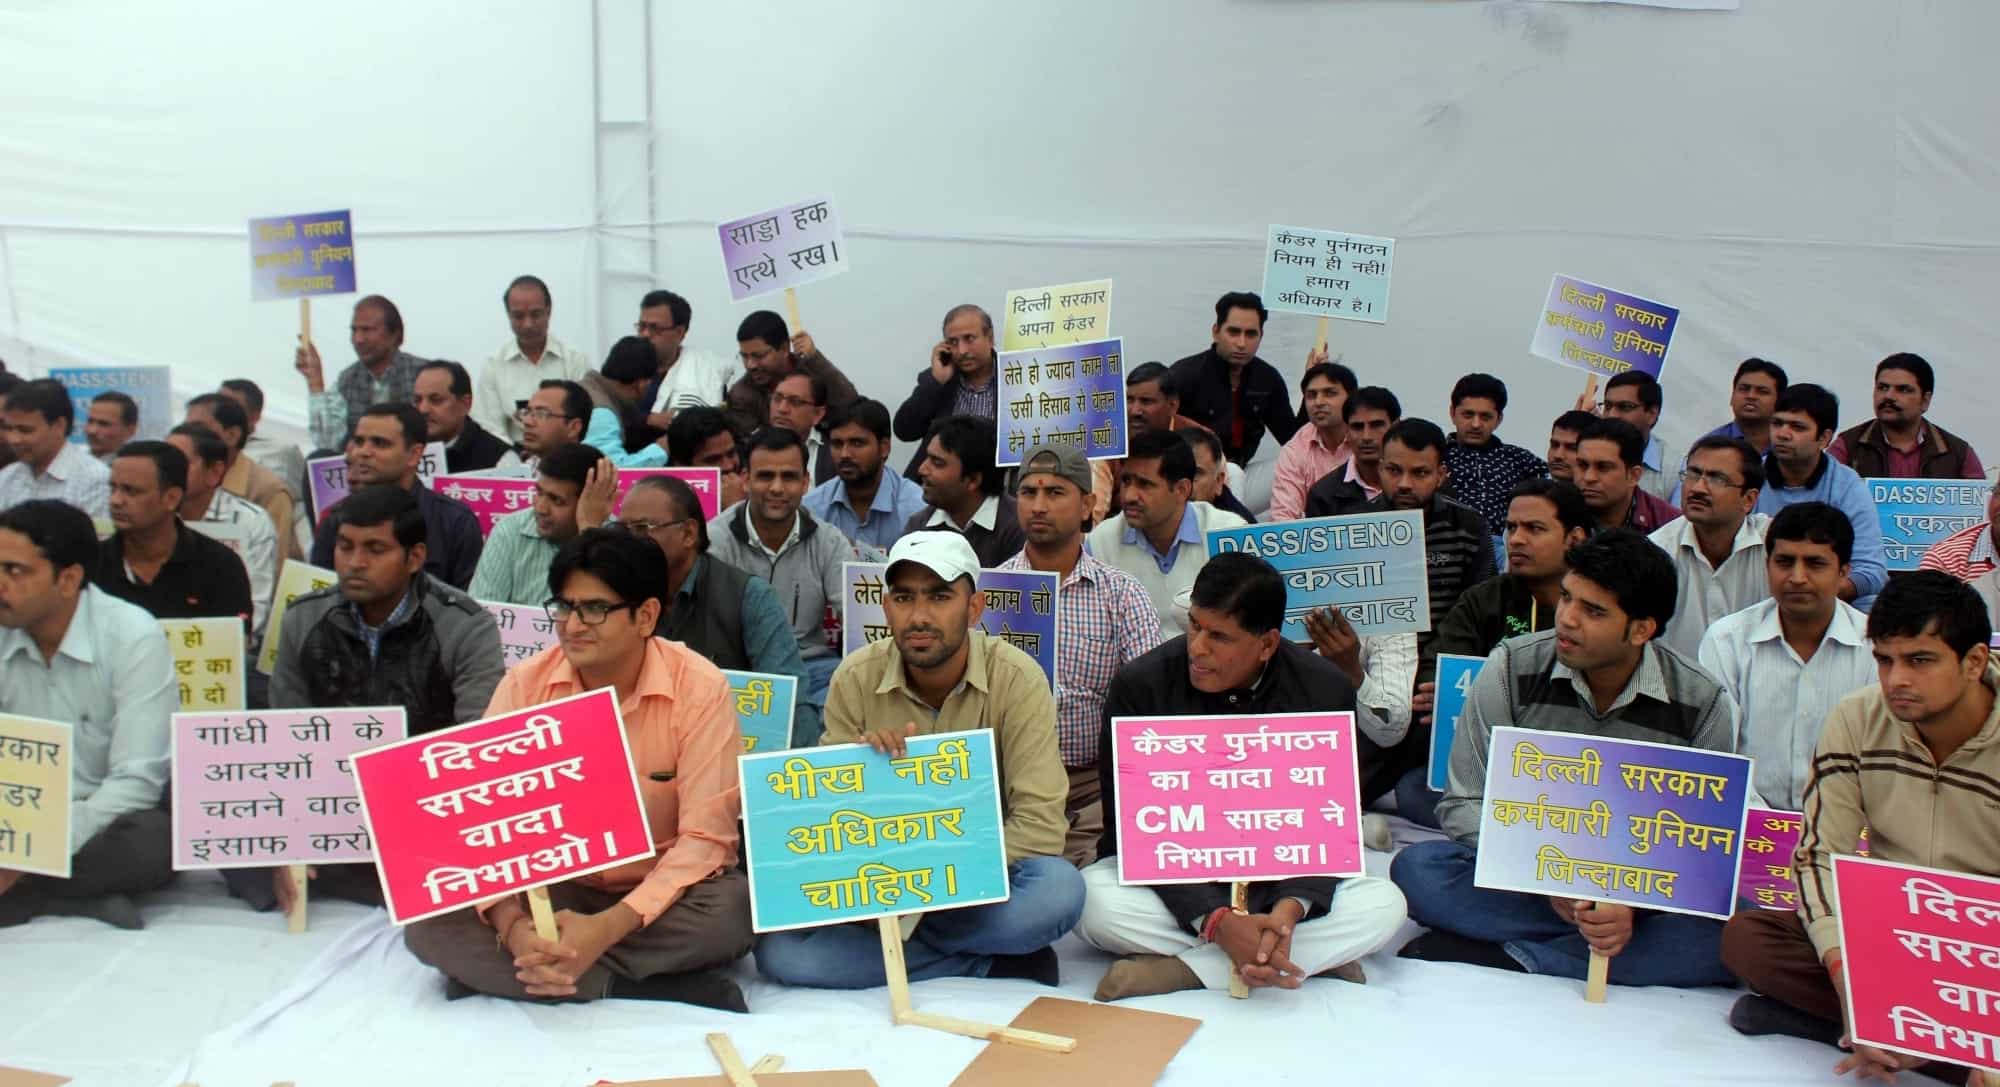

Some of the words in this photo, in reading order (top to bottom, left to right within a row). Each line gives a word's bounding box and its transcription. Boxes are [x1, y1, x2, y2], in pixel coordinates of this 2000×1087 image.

[728, 216, 780, 245] साड्डा
[792, 201, 827, 230] हक
[734, 252, 776, 290] एत्थे
[1273, 249, 1316, 268] नियम
[1326, 255, 1342, 271] ही
[1278, 290, 1342, 309] अधिकार
[1306, 275, 1350, 291] हमारा
[1013, 292, 1050, 314] दिल्ली
[1060, 290, 1106, 308] सरकार
[1561, 282, 1606, 312] दिल्ली
[1614, 303, 1668, 330] सरकार
[1018, 321, 1054, 337] अपना
[1004, 359, 1023, 386] लेते
[1028, 357, 1040, 385] हो
[1045, 360, 1076, 381] ज्यादा
[1080, 355, 1103, 377] काम
[1010, 392, 1033, 420] उसी
[1039, 391, 1071, 419] हिसाब
[1076, 387, 1086, 414] से
[1008, 427, 1025, 453] देने
[1874, 485, 1985, 505] DASS/STEN
[1217, 519, 1413, 558] DASS/STENO
[1280, 561, 1386, 592] कता
[853, 573, 884, 605] लेते
[1031, 582, 1052, 616] तो
[205, 657, 232, 675] का
[203, 682, 226, 704] दो
[731, 679, 774, 717] हीं
[194, 717, 268, 745] गांधी
[288, 715, 332, 742] जी
[352, 714, 385, 742] के
[1131, 727, 1208, 756] कैडर
[1223, 725, 1339, 762] पुर्नगठन
[419, 715, 563, 780] दिल्ली
[768, 757, 867, 800] भीख
[889, 739, 971, 786] नहीं
[1148, 770, 1191, 791] का
[1207, 768, 1273, 789] वादा
[1288, 766, 1326, 787] था
[1512, 741, 1602, 786] दिल्ली
[1619, 762, 1729, 802] सरकार
[0, 782, 42, 810] डर
[417, 756, 585, 818] सरकार
[200, 791, 285, 819] चलने
[1135, 804, 1205, 833] CM
[1223, 808, 1305, 831] साहब
[1320, 800, 1346, 827] ने
[459, 804, 564, 848] वादा
[786, 807, 965, 856] अधिकार
[1492, 793, 1613, 838] कर्मचारी
[1628, 808, 1736, 855] युनियन
[189, 829, 289, 862] इंसाफ
[1155, 841, 1257, 870] निभाना
[1536, 844, 1679, 899] जिन्दाबाद
[1888, 1005, 2000, 1063] निभा
